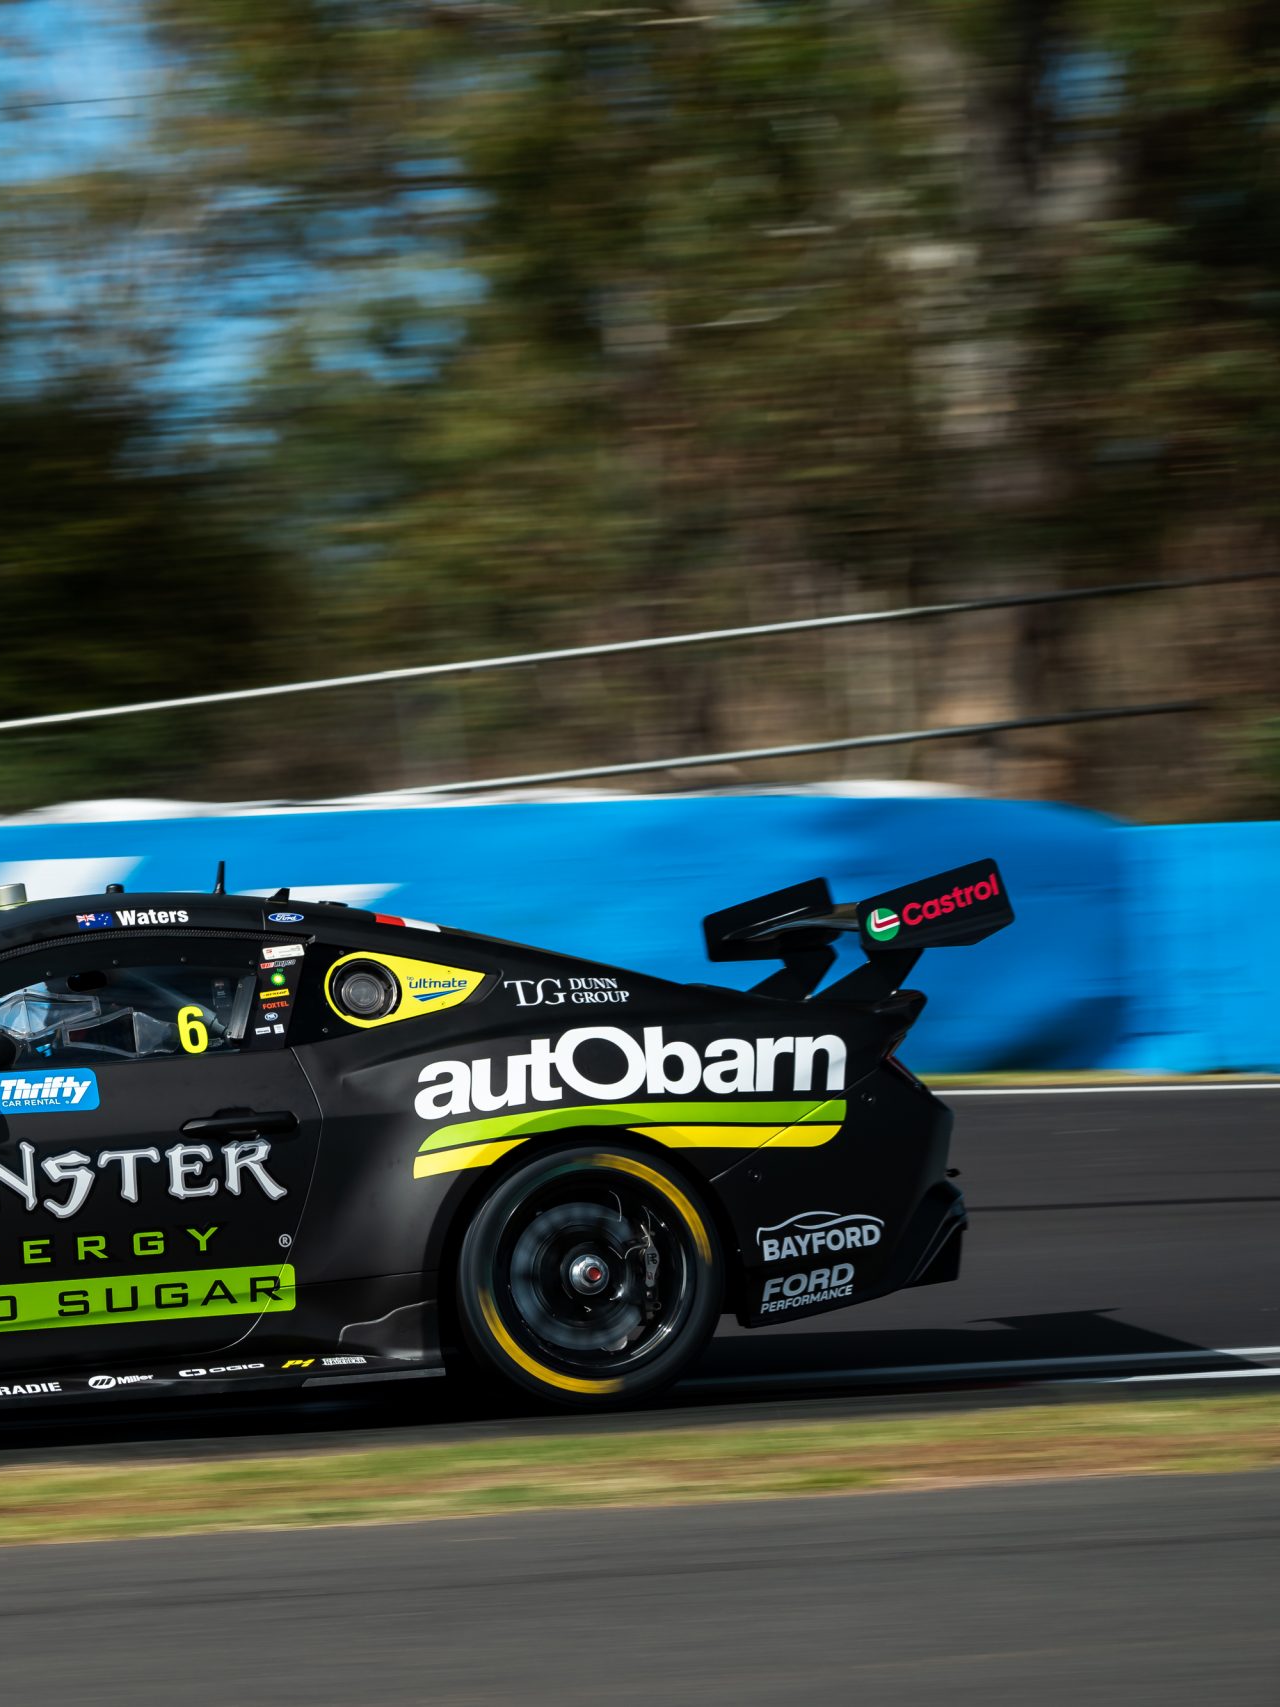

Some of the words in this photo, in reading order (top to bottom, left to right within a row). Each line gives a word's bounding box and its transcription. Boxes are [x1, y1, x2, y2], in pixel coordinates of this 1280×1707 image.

[902, 873, 1000, 926] Castrol
[116, 908, 189, 927] Waters
[409, 977, 467, 989] ultimate
[568, 977, 618, 990] DUNN
[262, 1000, 289, 1009] FOXTEL
[571, 990, 630, 1004] GROUP
[177, 1005, 209, 1054] 6
[0, 1076, 92, 1105] Thrifty
[24, 1098, 61, 1106] RENTAL
[762, 1224, 882, 1262] BAYFORD
[762, 1262, 855, 1302] FORD
[57, 1275, 282, 1318] SUGAR
[760, 1284, 854, 1314] PERFORMANCE
[116, 1374, 154, 1385] Miller
